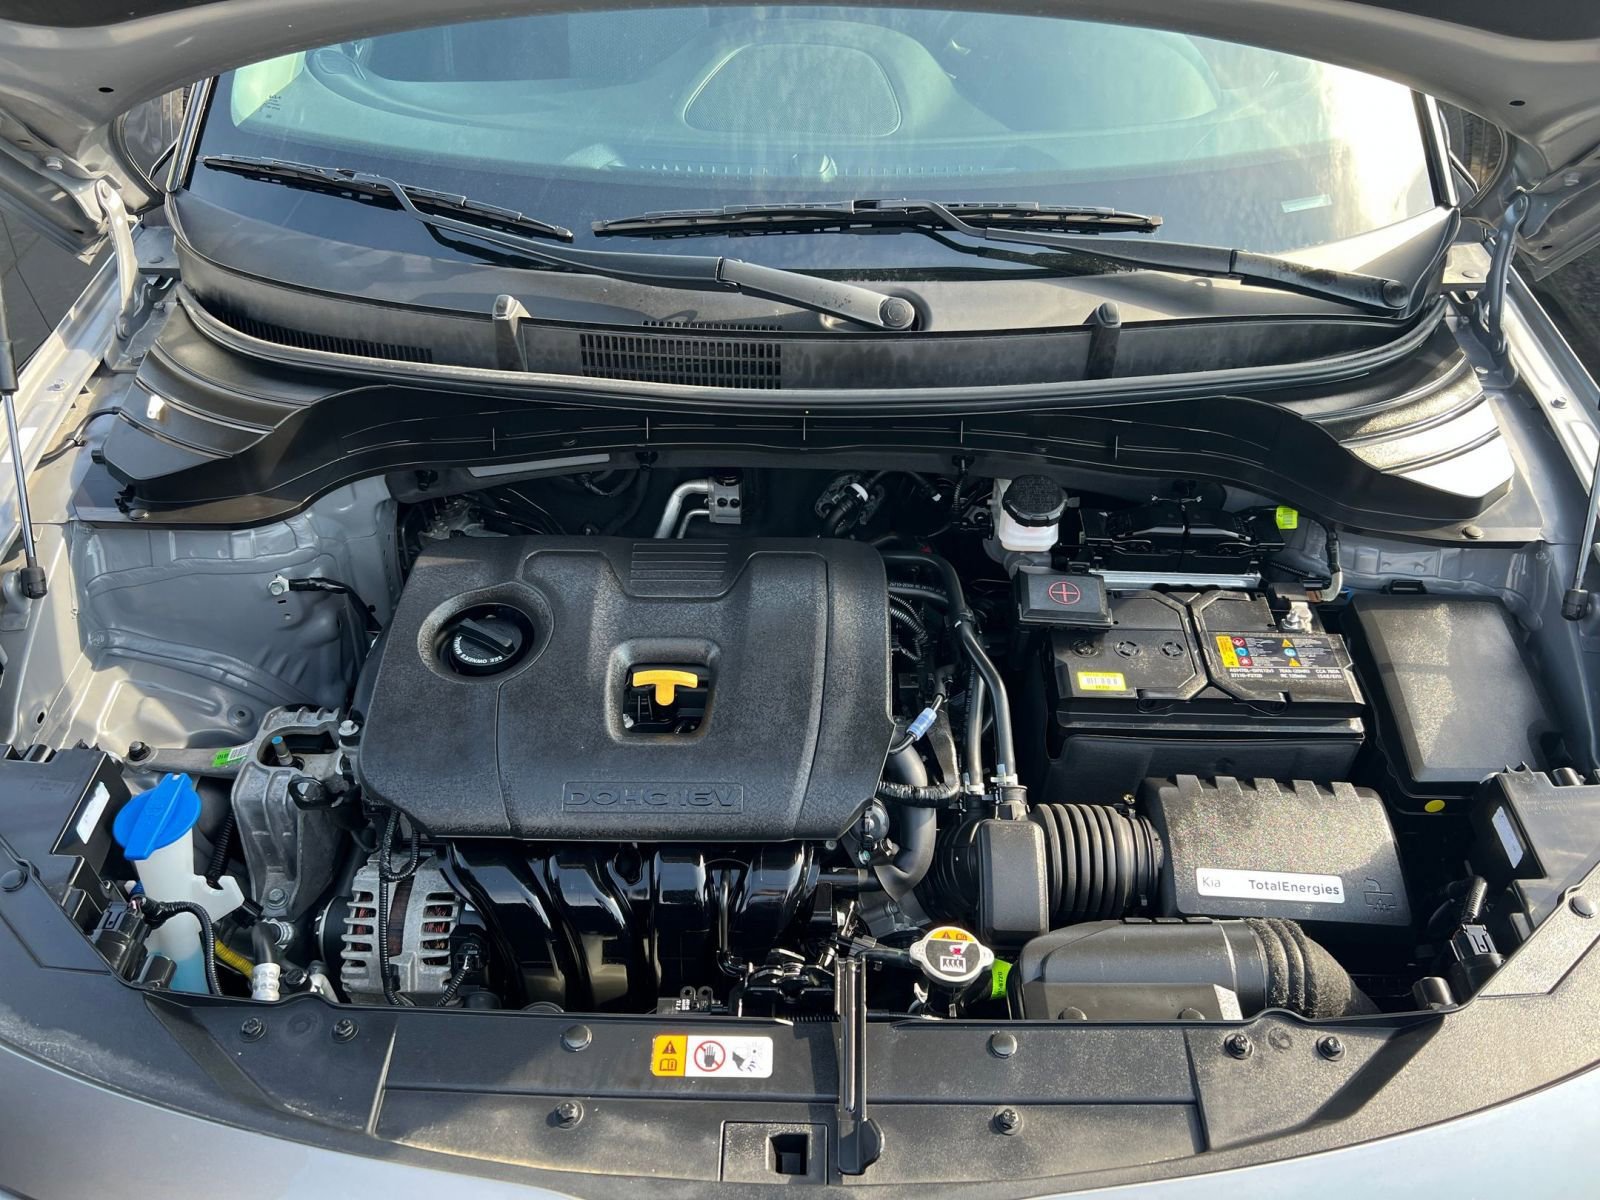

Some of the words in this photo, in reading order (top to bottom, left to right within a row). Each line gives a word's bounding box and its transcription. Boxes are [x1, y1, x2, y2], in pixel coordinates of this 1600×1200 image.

[489, 655, 503, 663] SEE
[565, 789, 669, 806] DOHC
[676, 789, 738, 808] 16V
[1202, 876, 1221, 888] Kia
[1248, 879, 1340, 896] TotalEnergies
